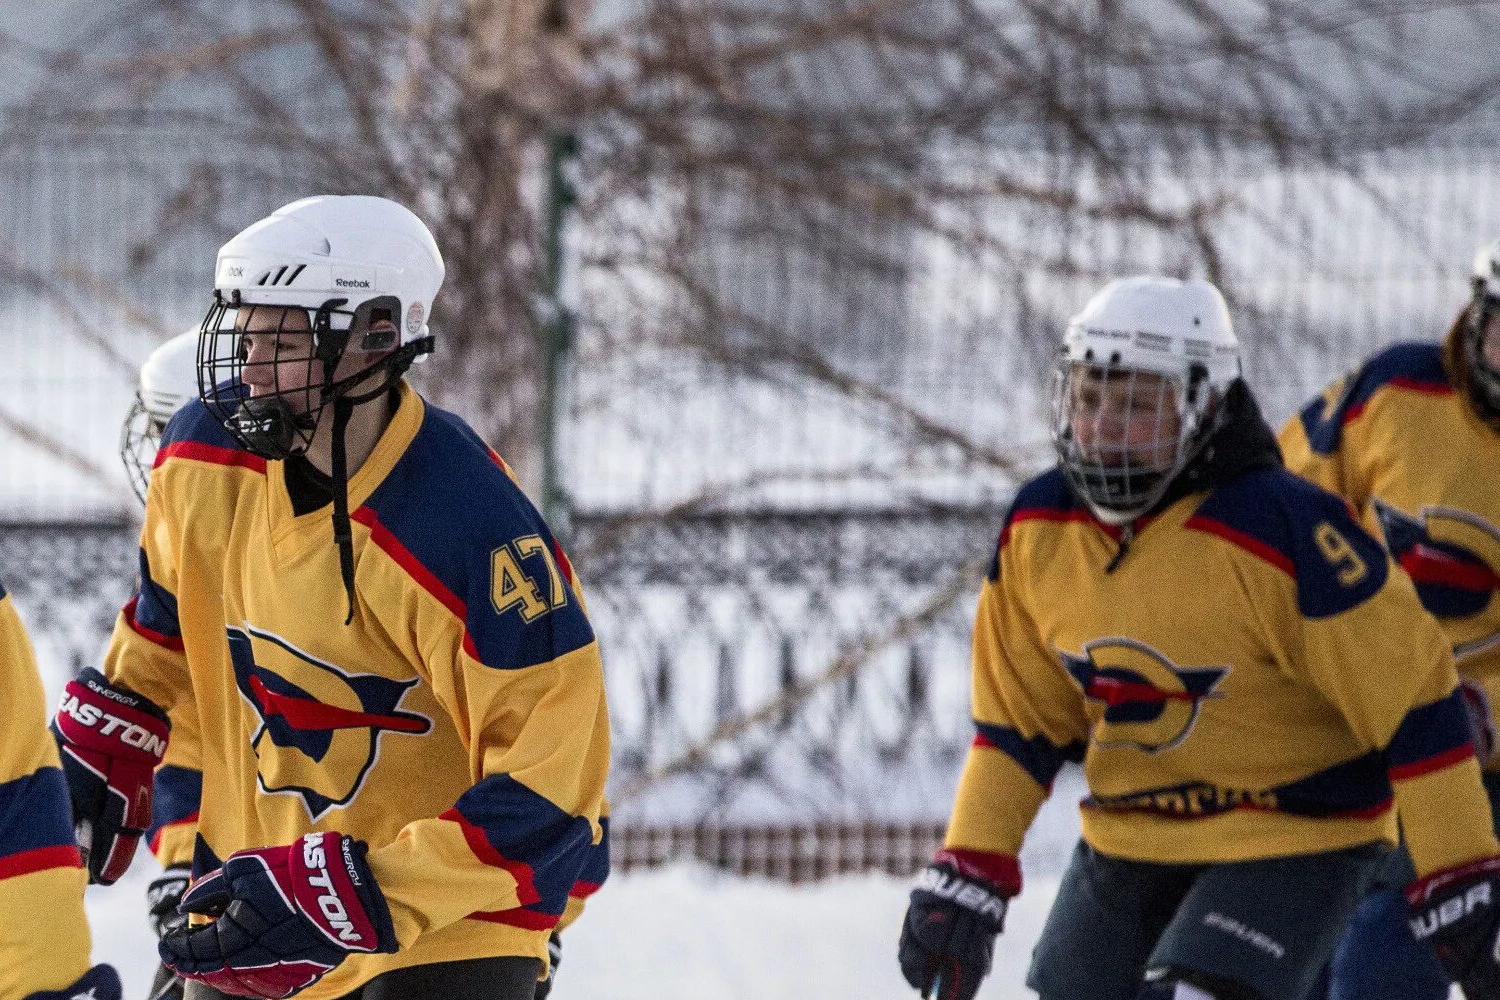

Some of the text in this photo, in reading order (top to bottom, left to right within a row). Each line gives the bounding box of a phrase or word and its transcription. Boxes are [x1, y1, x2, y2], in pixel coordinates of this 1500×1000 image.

[335, 278, 371, 289] Reebok
[490, 533, 567, 625] 47
[1314, 523, 1369, 587] 9
[87, 680, 140, 707] SYNERGY
[303, 832, 362, 942] ASTON
[342, 838, 363, 886] SYNERGY
